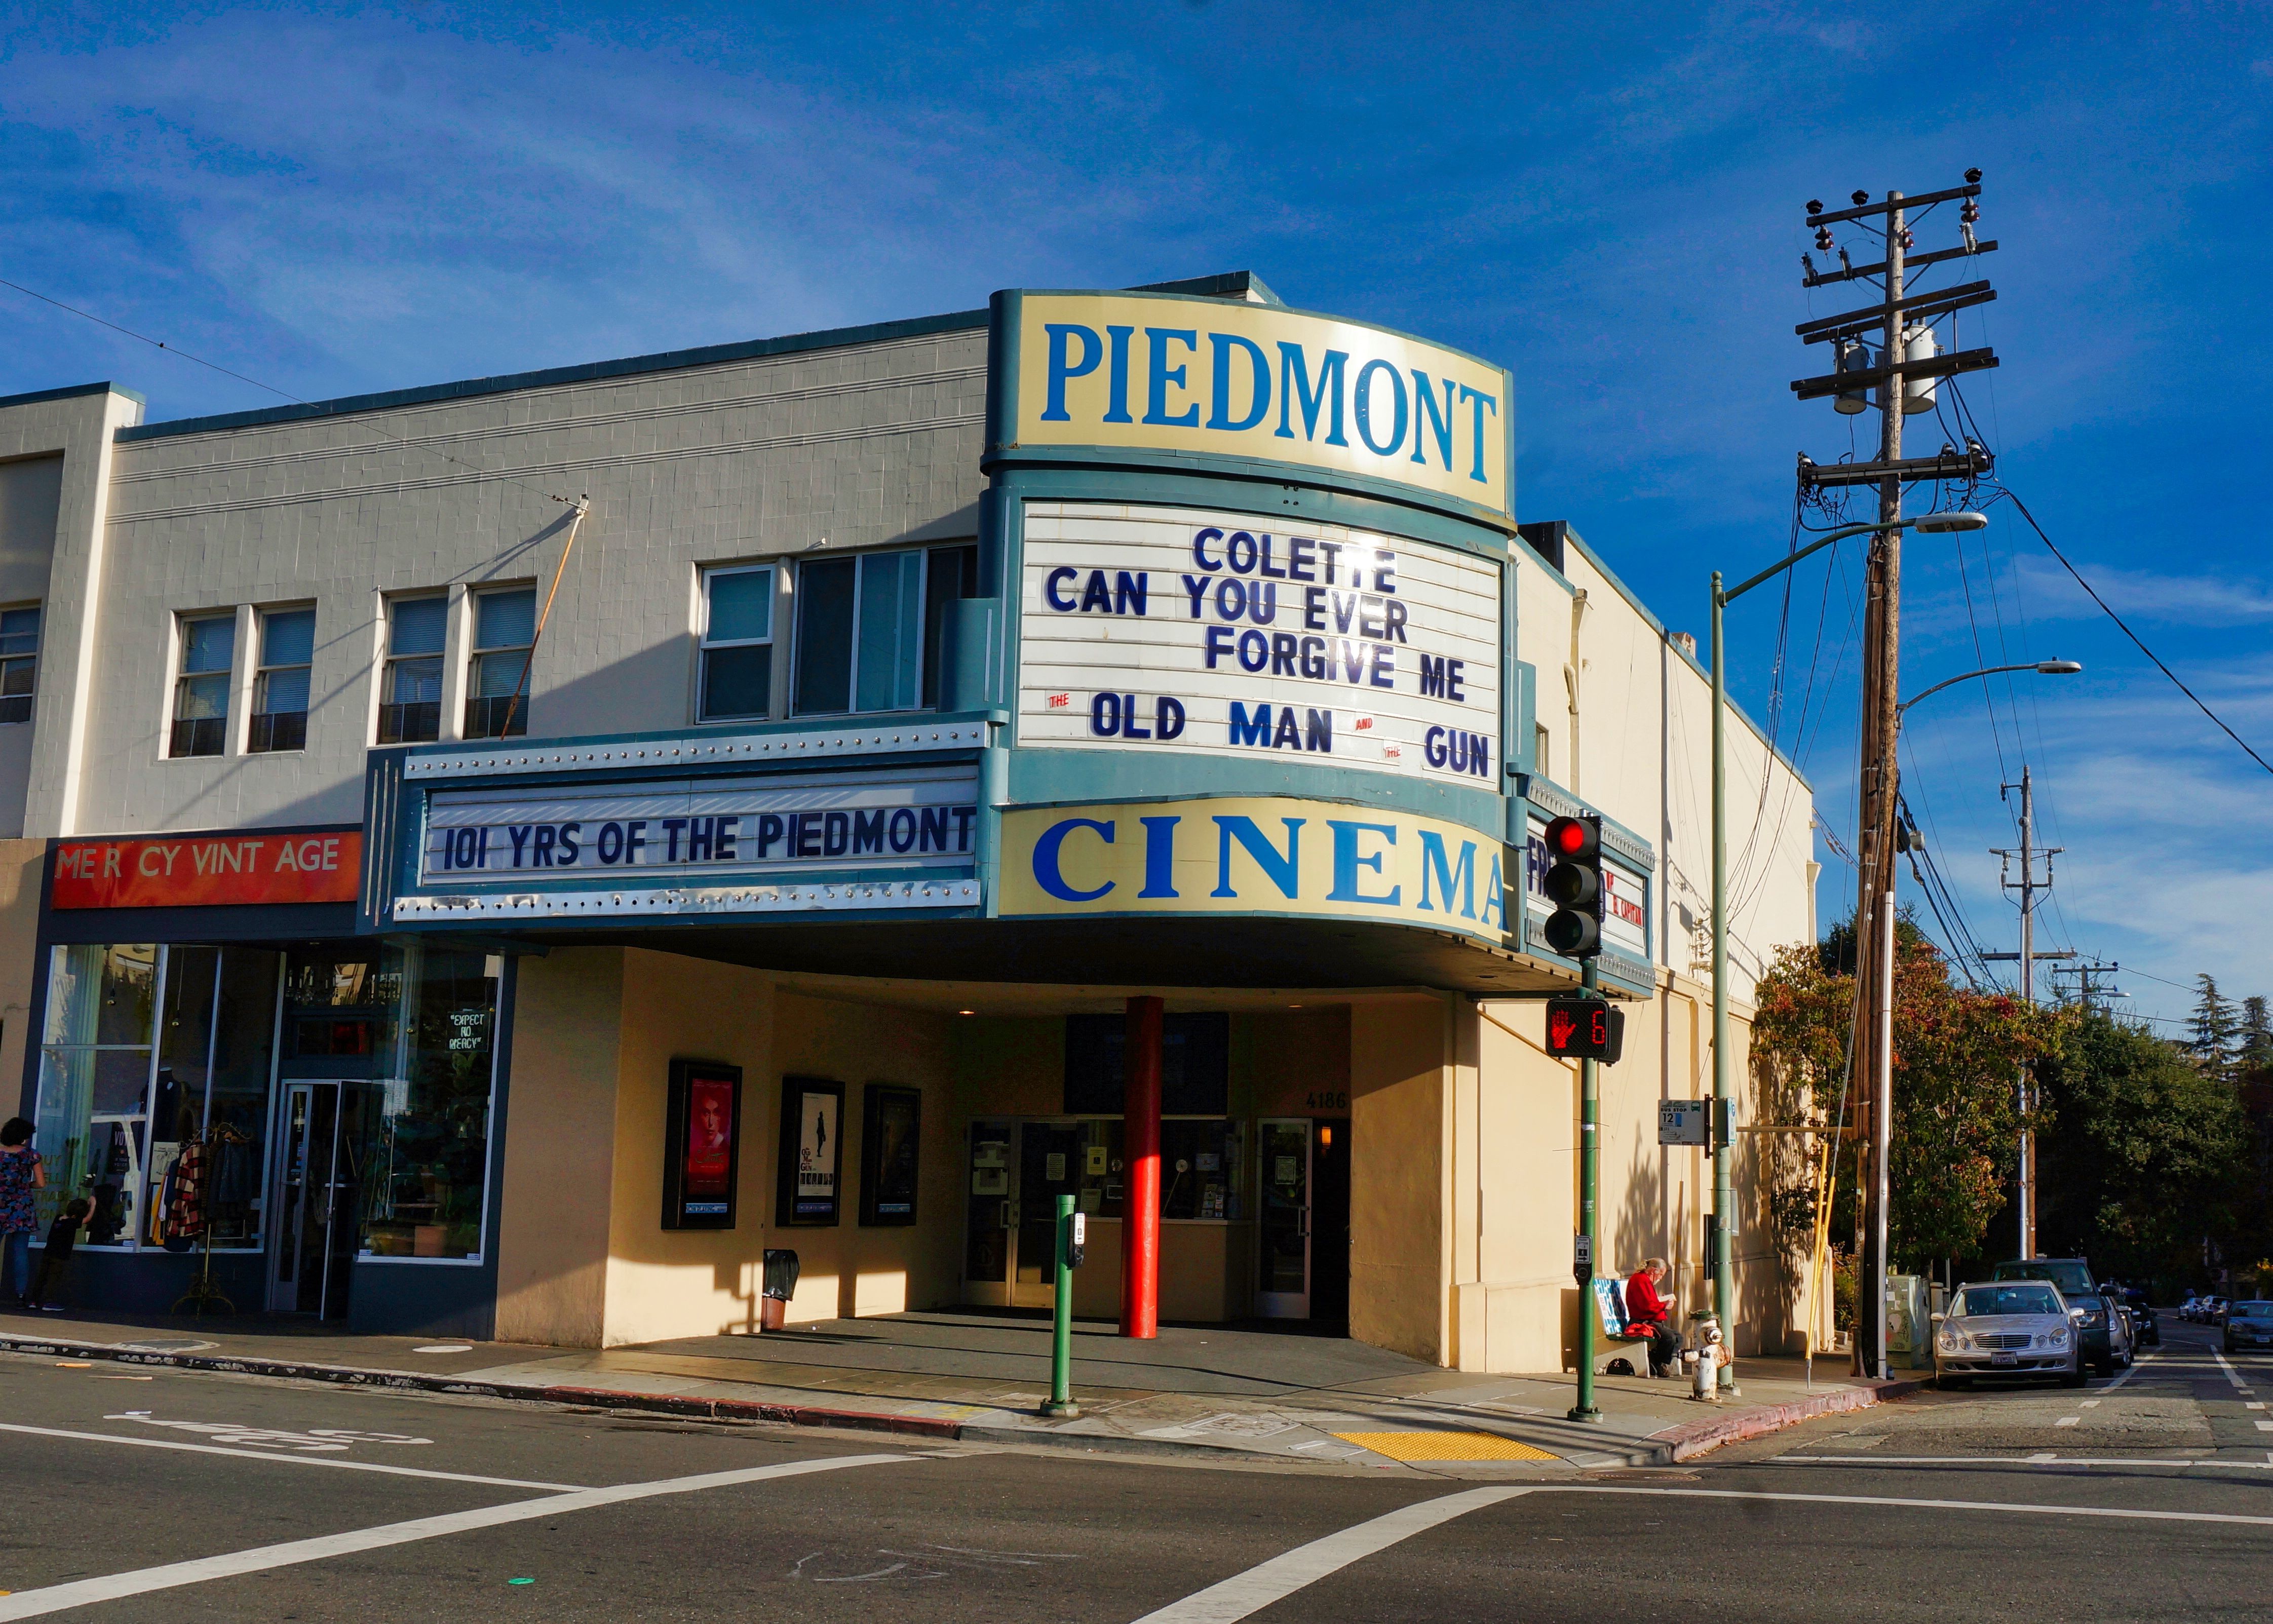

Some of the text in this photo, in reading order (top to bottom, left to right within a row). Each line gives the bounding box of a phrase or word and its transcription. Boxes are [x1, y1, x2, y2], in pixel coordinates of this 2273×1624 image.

[1041, 324, 1496, 484] PIEDMONT
[1193, 527, 1396, 594] COLETTE
[1045, 567, 1407, 644] CAN YOU EVER
[1206, 626, 1465, 703] FORGIVE ME
[1048, 692, 1488, 778] THE OLD MAN AND THE GUN
[508, 823, 581, 867] YRS
[597, 821, 647, 864] OF
[662, 816, 739, 862] THE
[757, 806, 978, 858] PIEDMONT
[1032, 816, 1510, 932] CINEMA
[460, 1026, 472, 1037] NO
[1592, 1010, 1605, 1044] 6
[1306, 1091, 1346, 1109] 4186
[1663, 1113, 1674, 1123] 12
